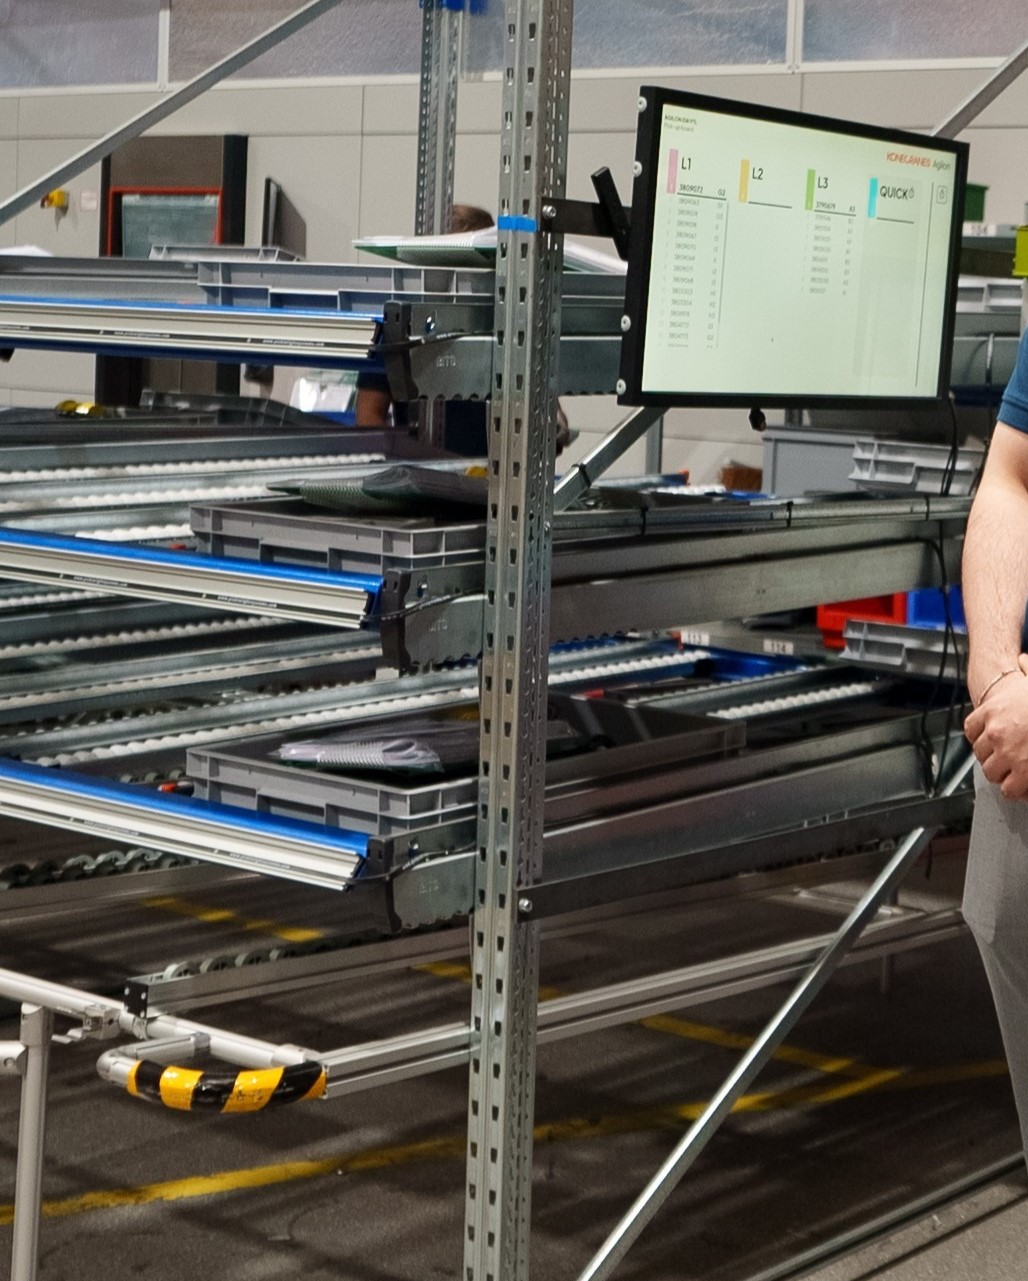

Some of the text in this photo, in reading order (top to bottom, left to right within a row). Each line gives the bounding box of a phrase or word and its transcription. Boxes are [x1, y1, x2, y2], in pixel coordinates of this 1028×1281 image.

[681, 156, 692, 171] L1
[752, 167, 764, 181] L2
[817, 176, 829, 189] L3
[879, 185, 908, 200] QUICK
